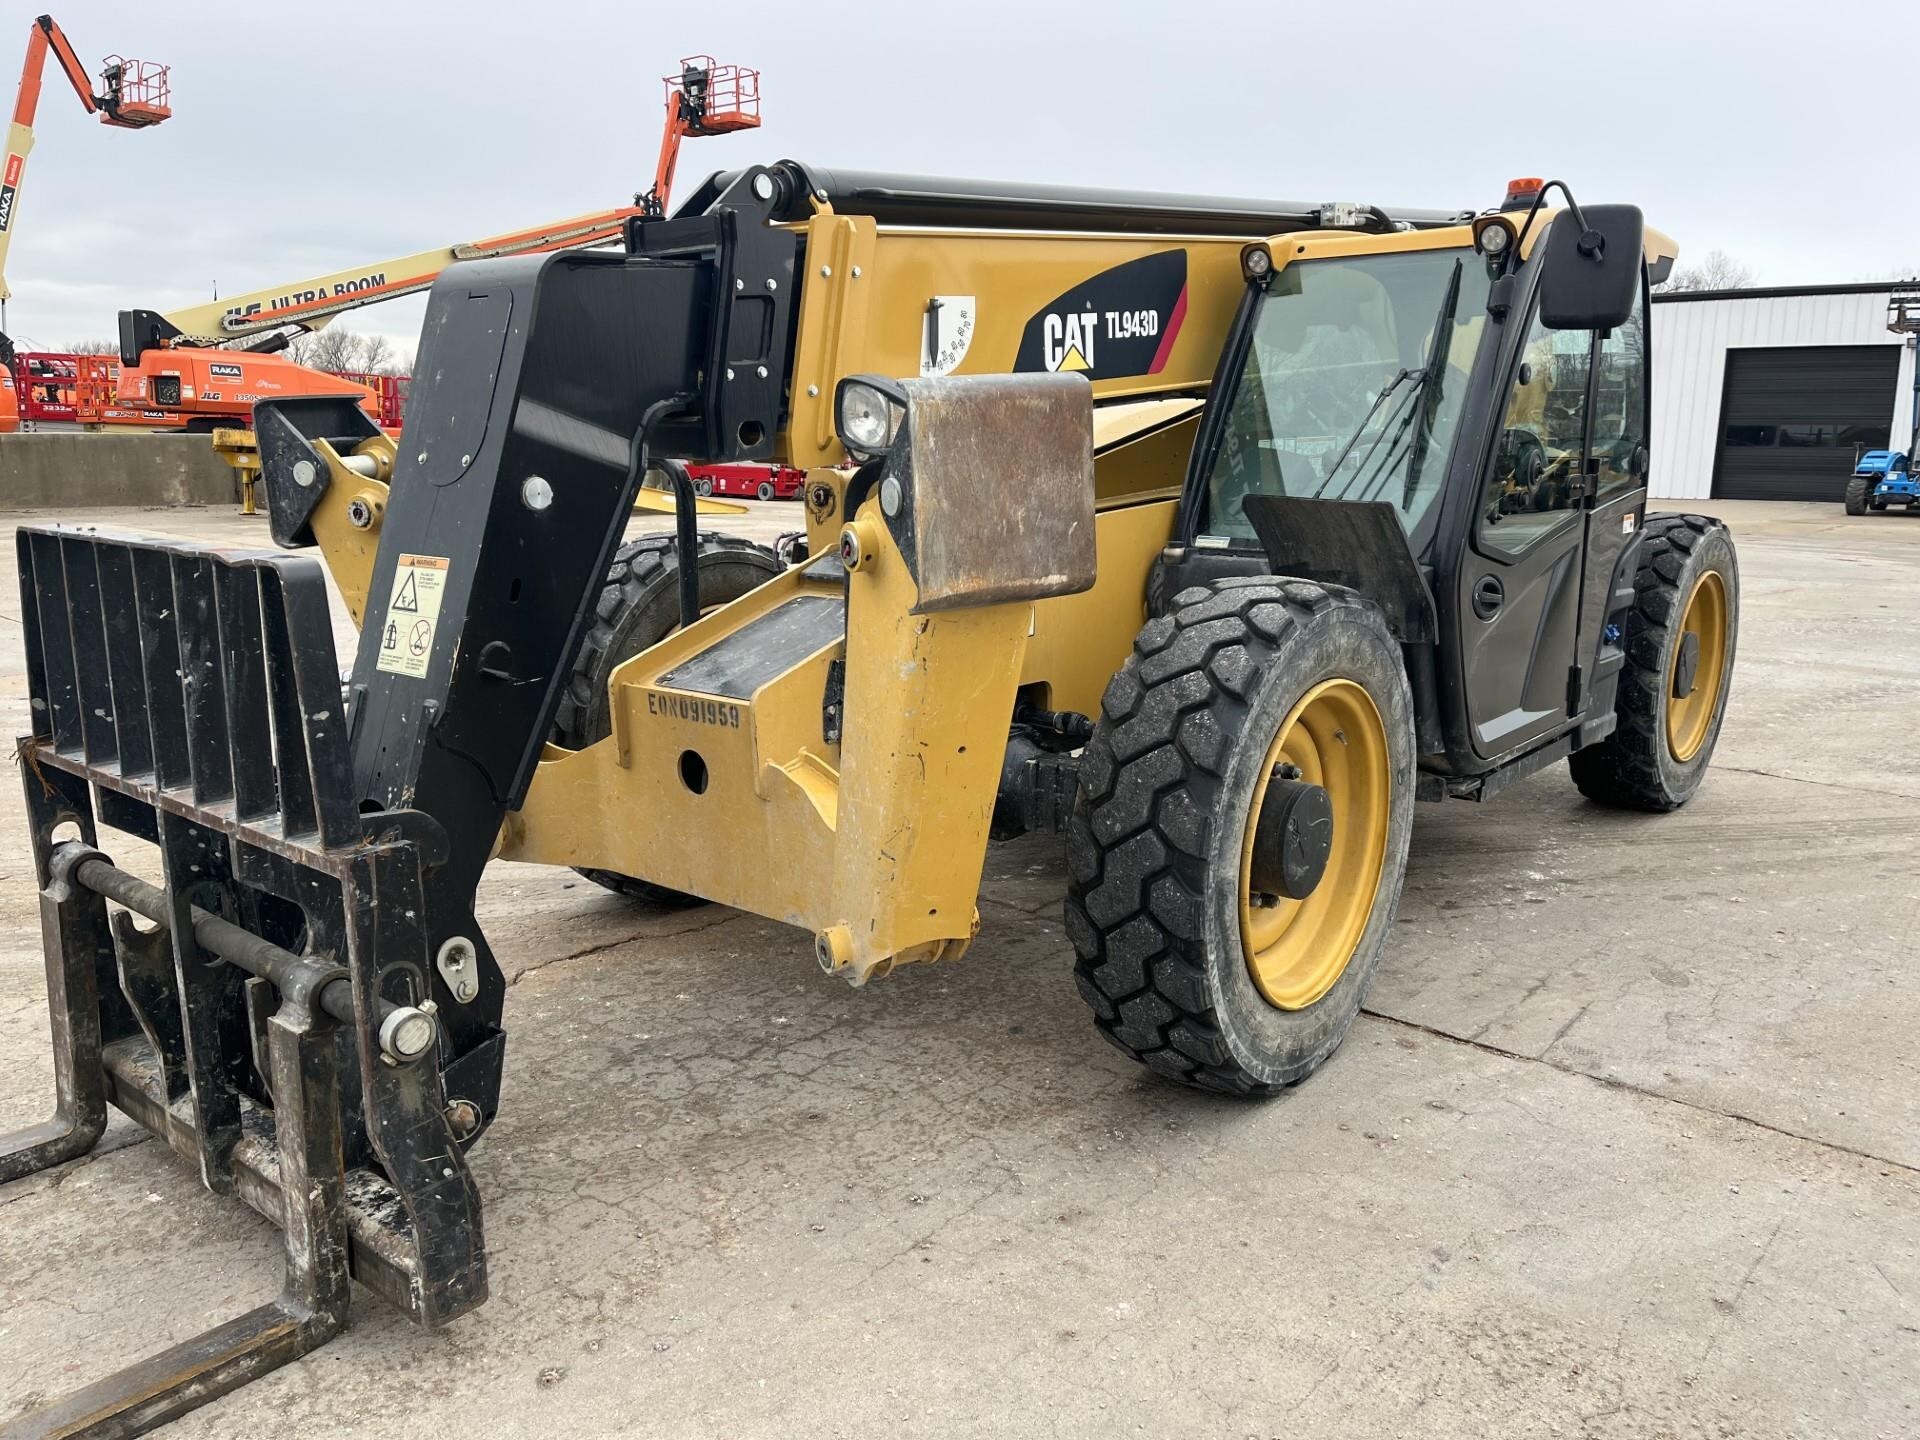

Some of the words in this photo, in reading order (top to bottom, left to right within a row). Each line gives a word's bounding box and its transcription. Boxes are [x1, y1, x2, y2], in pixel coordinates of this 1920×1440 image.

[271, 287, 328, 310] ULTRA
[333, 273, 386, 296] BOOM
[1044, 312, 1098, 372] CAT
[1105, 309, 1158, 338] TL943D
[211, 366, 241, 376] RAKA
[201, 392, 221, 401] JLG
